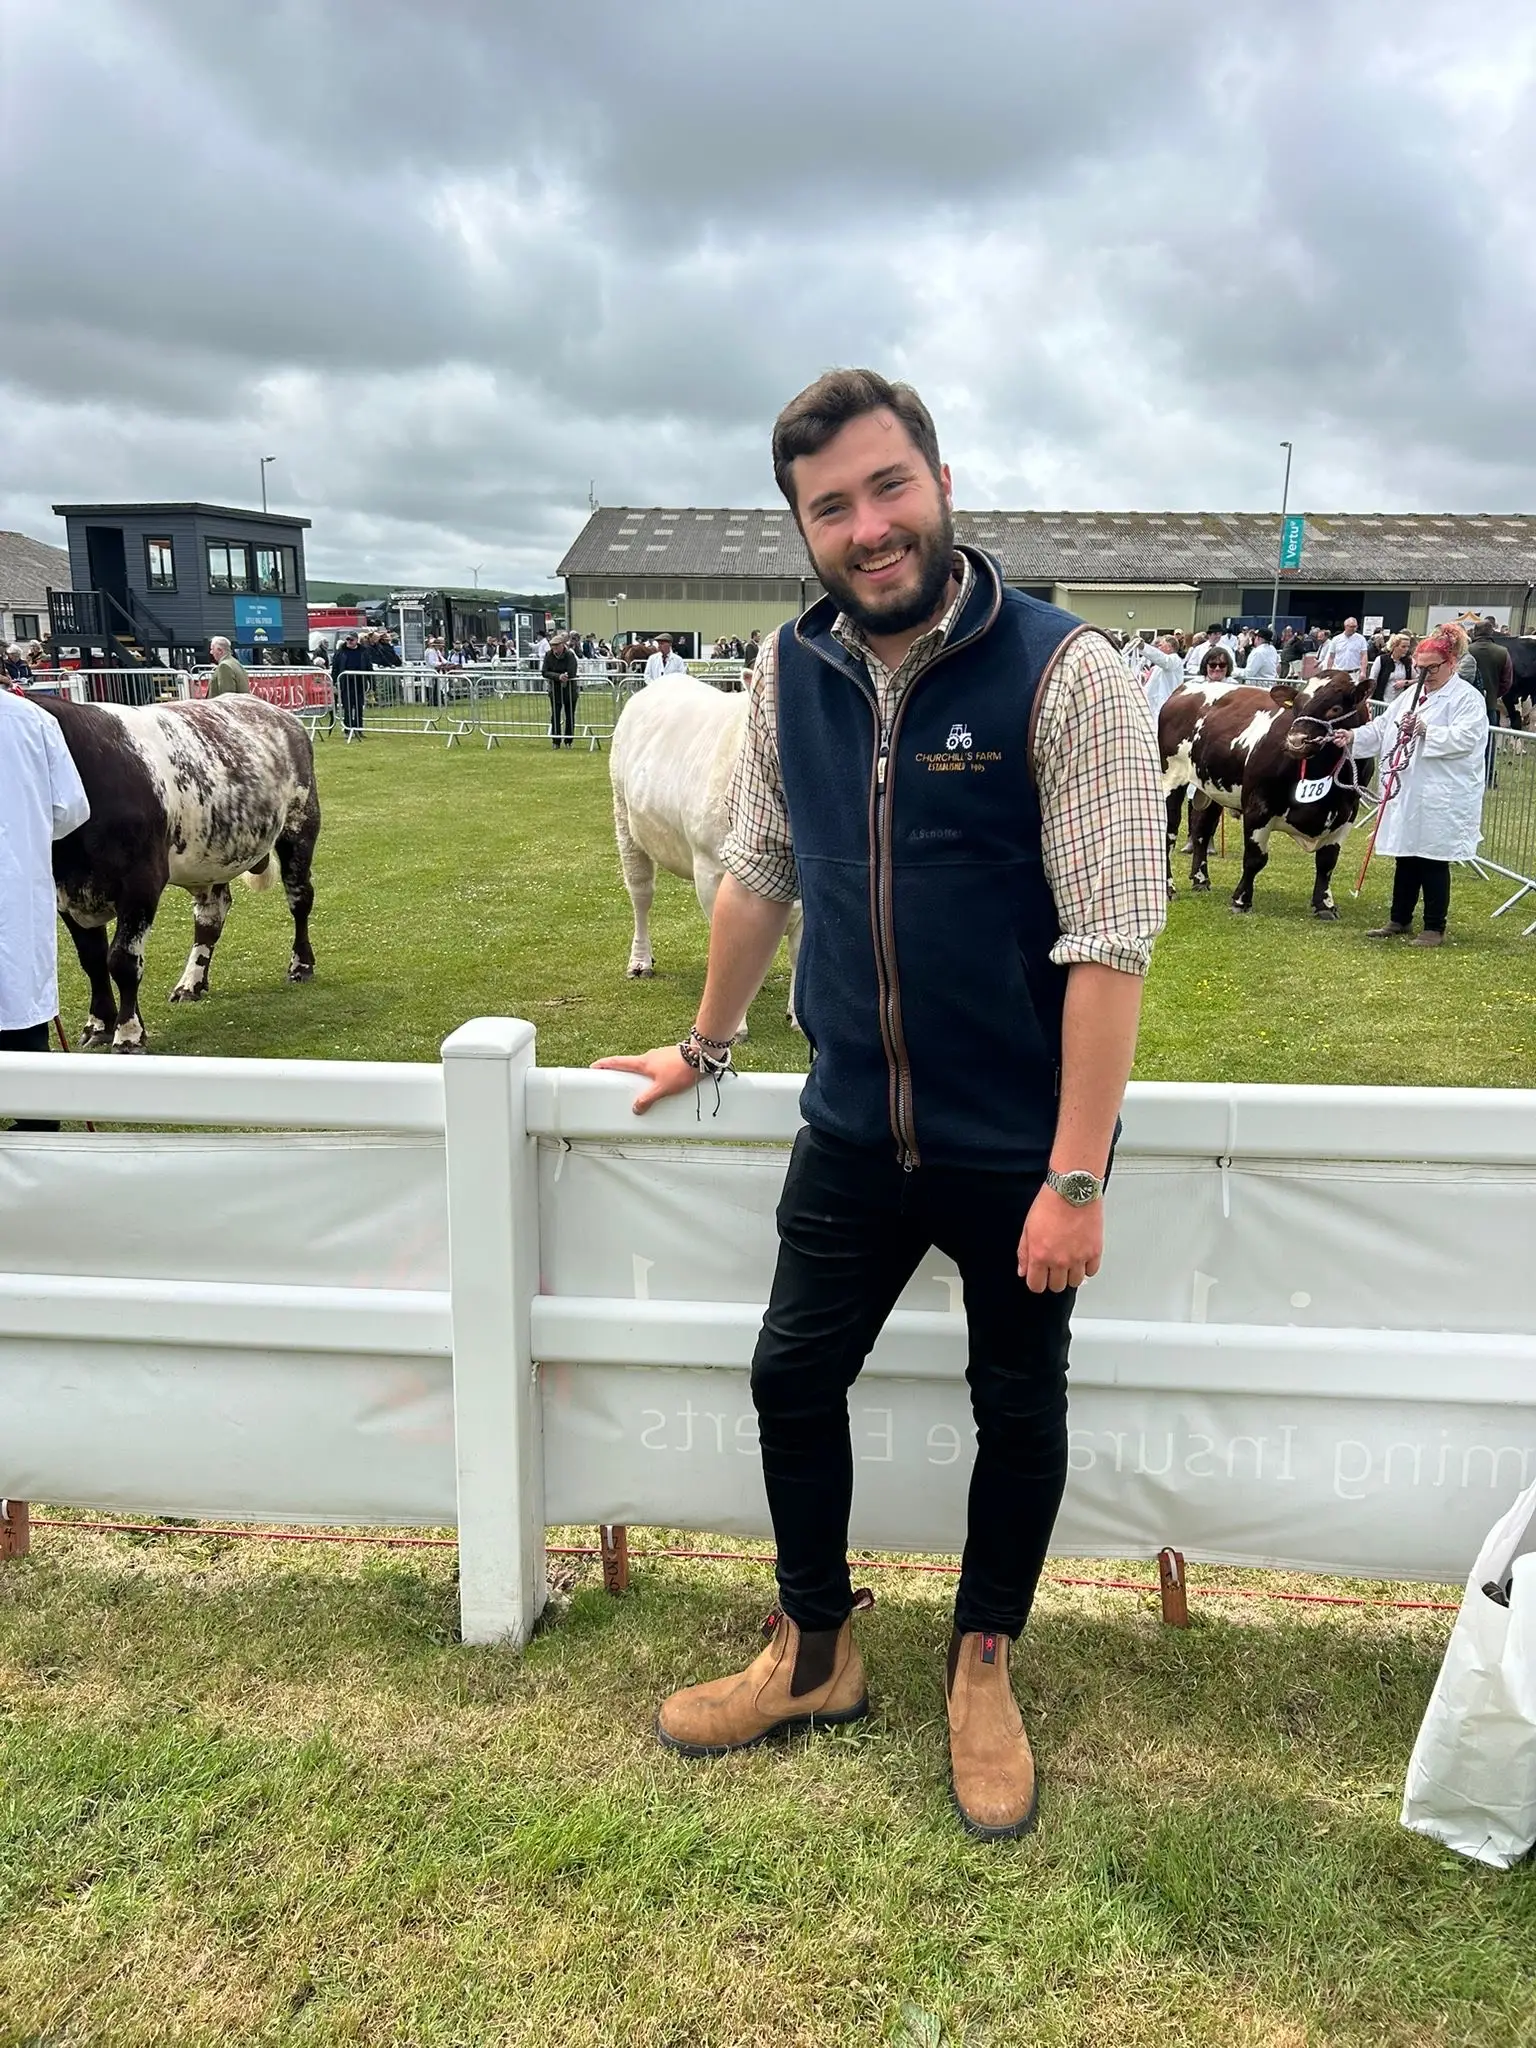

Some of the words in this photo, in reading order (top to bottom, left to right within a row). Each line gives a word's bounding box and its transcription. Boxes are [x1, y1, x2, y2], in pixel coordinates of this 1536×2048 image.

[1286, 526, 1299, 559] Vertu
[915, 751, 973, 762] CHURCHILL'S
[975, 751, 1002, 761] FARM
[927, 762, 966, 772] ESTABLISHED
[1301, 782, 1325, 798] 178
